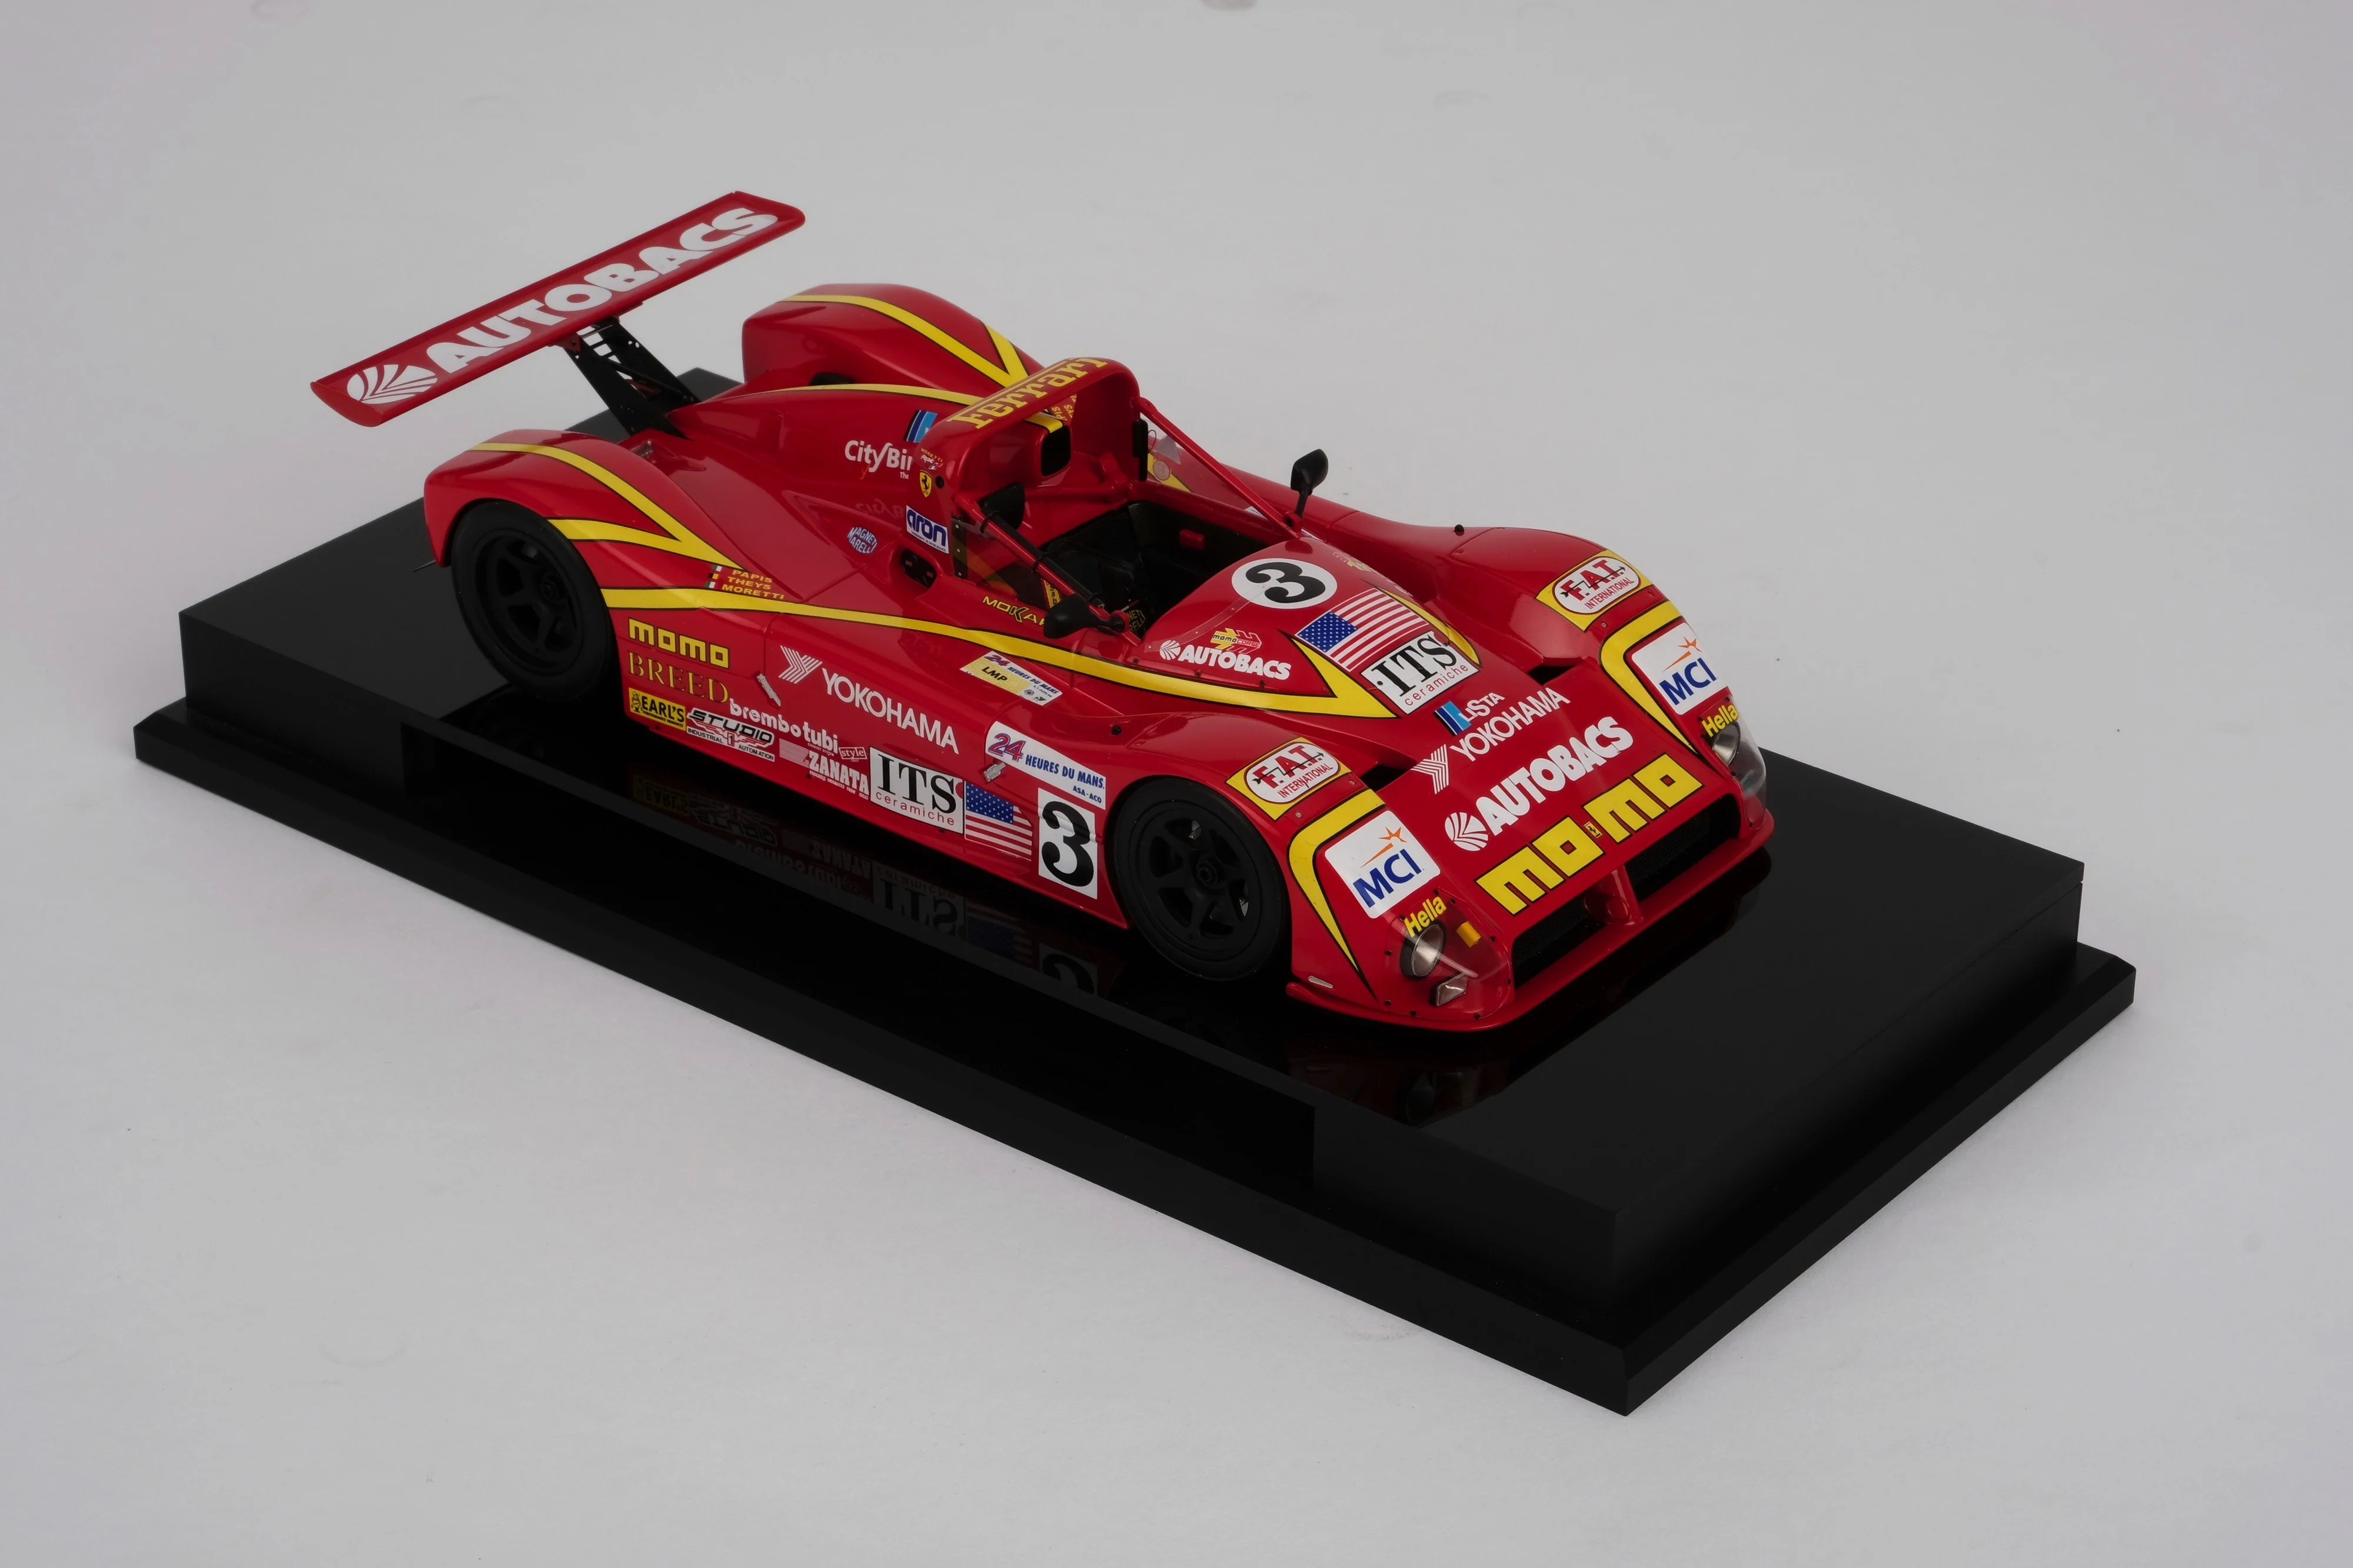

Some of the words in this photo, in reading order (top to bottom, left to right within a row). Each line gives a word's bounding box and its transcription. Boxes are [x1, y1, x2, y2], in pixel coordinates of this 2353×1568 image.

[426, 208, 778, 373] AUTOBACS
[721, 584, 785, 599] MORETTI
[727, 576, 771, 590] THEYS
[732, 569, 772, 583] PAPIS
[1245, 561, 1326, 603] 3
[1585, 578, 1634, 609] INTERNATIONAL
[628, 651, 729, 704] BREED
[981, 666, 1008, 681] LMP
[983, 654, 1011, 666] 24
[1007, 666, 1031, 679] HEURES
[1039, 683, 1059, 695] MANS
[1178, 645, 1291, 680] AUTOBACS
[1370, 634, 1457, 698] ITS
[1659, 657, 1718, 706] MCI
[1404, 663, 1469, 706] ceramiche
[641, 695, 685, 722] EARL'S
[689, 709, 773, 743] STUDIO
[821, 668, 960, 755] YOKOHAMA
[1449, 687, 1572, 762] YOKOHAMA
[1702, 703, 1739, 738] Hella
[688, 728, 724, 744] INDUSTRIAL
[738, 744, 774, 761] AUTOMATION
[841, 749, 865, 759] style
[988, 733, 1026, 762] 24
[1025, 755, 1059, 774] HEURES
[1062, 766, 1075, 779] DU
[809, 750, 870, 795] ZANATA
[876, 753, 956, 814] ITS
[1277, 763, 1334, 799] INTERNATIONAL
[1475, 716, 1633, 836] AUTOBACS
[875, 790, 955, 827] ceramiche
[1041, 800, 1095, 888] 3
[1352, 848, 1422, 909] MCI
[1404, 896, 1447, 938] Hella
